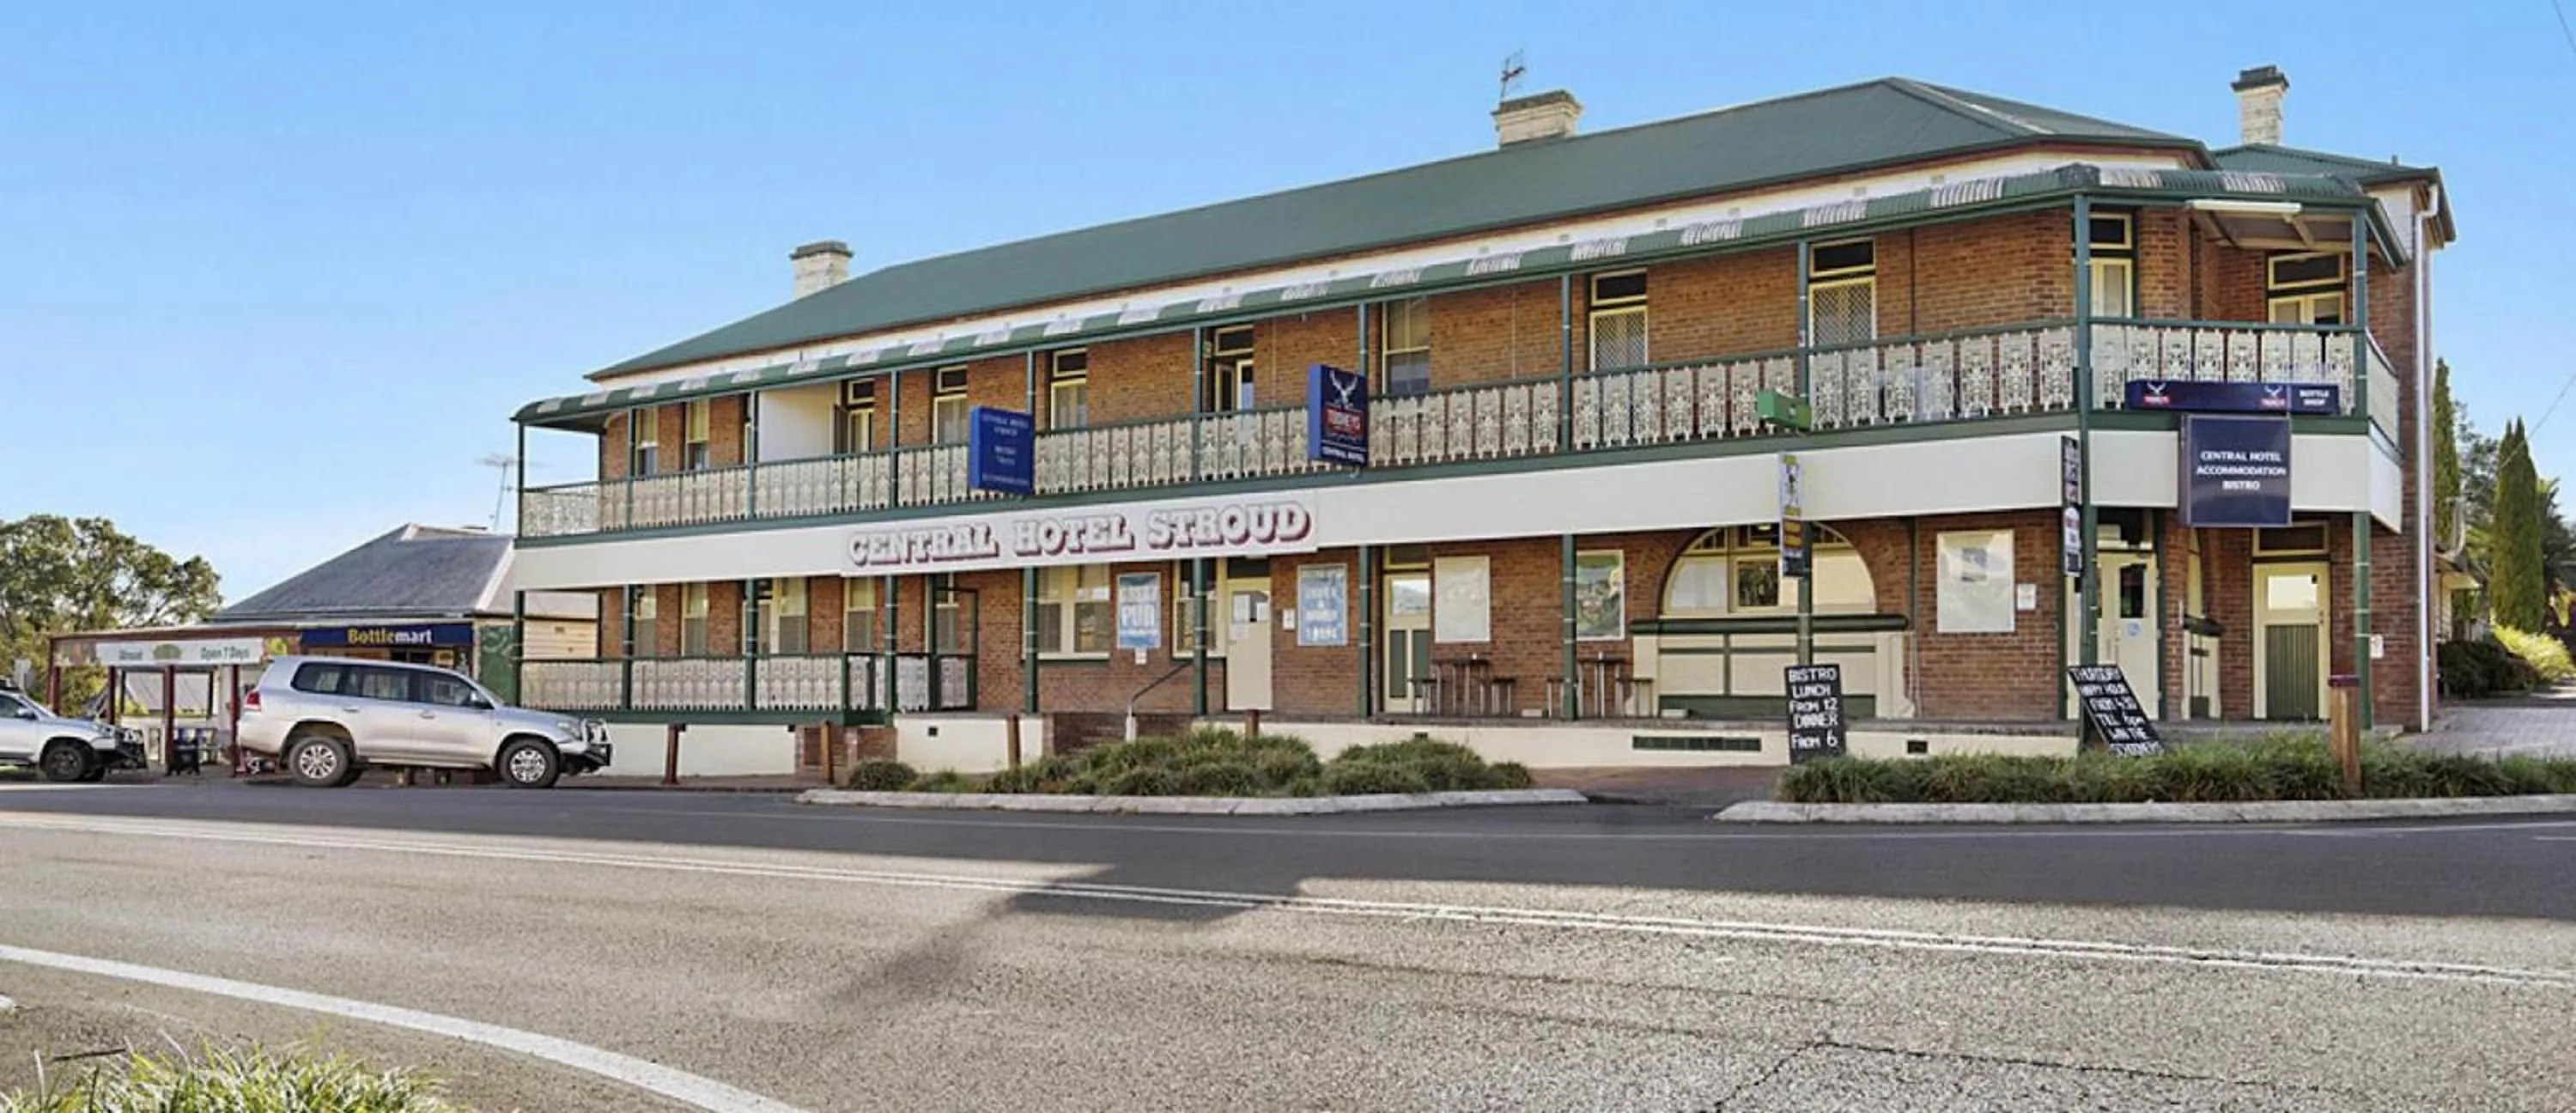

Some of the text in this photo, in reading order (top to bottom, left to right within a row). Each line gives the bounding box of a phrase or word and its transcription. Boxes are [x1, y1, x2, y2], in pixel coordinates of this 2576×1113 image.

[2200, 450, 2281, 462] CENTRAL HOTEL
[2196, 465, 2287, 476] ACCOMMODATION
[2221, 480, 2261, 490] BISTRO
[849, 501, 1311, 567] CENTRAL HOTEL STROUD
[347, 627, 432, 644] Bottlemart
[200, 647, 222, 660] Open
[229, 646, 250, 660] Days
[1789, 668, 1837, 683] BISTRO
[1792, 684, 1832, 699] LUNCH
[1823, 696, 1838, 711] 12
[1792, 712, 1838, 729] DINNER
[1826, 728, 1838, 747] 6
